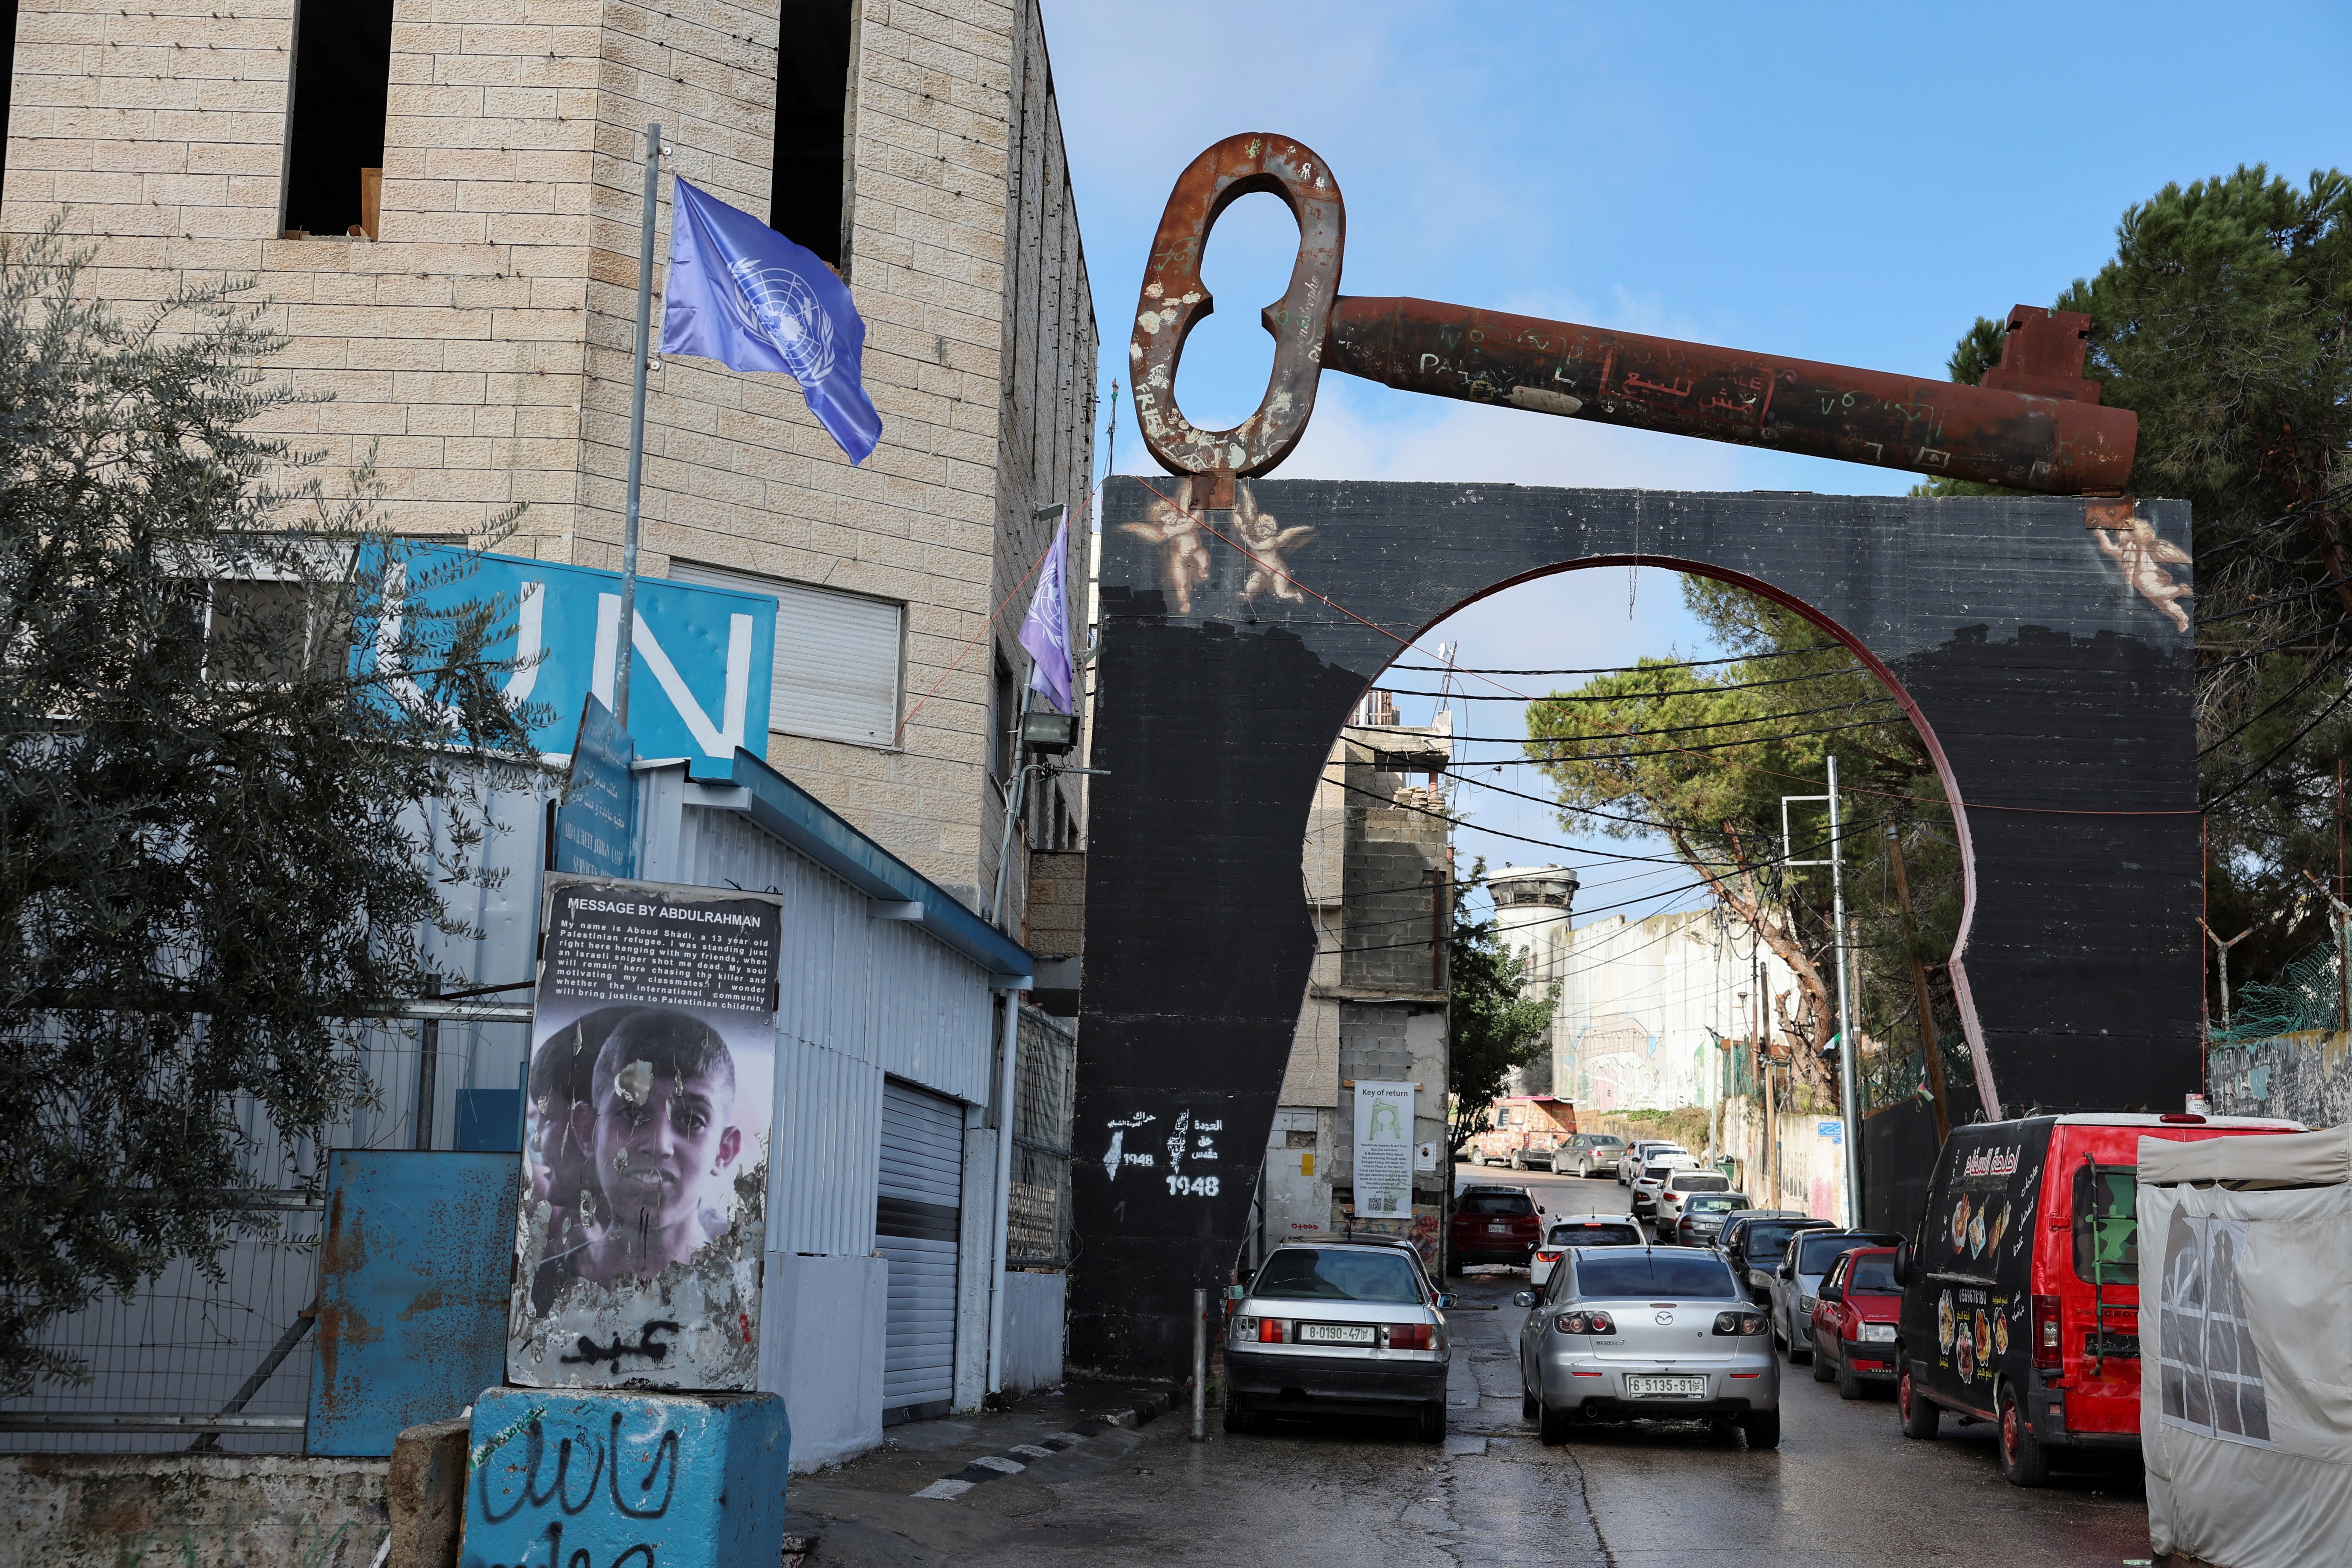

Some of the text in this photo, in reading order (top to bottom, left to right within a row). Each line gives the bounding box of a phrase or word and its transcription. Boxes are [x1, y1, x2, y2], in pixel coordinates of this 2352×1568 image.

[1622, 372, 1753, 414] مش للبيع
[376, 561, 753, 759] UN
[581, 830, 593, 850] BEIT
[568, 898, 760, 927] MESSAGE BY ABDULRAHMAN
[561, 920, 574, 929] My
[627, 927, 658, 935] Aboud
[664, 930, 694, 940] Shadi,
[560, 930, 618, 941] Palestinian
[624, 936, 665, 945] refugee.
[703, 944, 744, 955] standing
[560, 940, 584, 948] right
[589, 942, 610, 950] here
[615, 944, 655, 956] hanging
[659, 948, 680, 957] with
[702, 953, 739, 964] friends,
[576, 950, 609, 960] Israeli
[615, 954, 647, 963] sniper
[729, 965, 741, 973] My
[557, 978, 597, 987] whether
[637, 984, 701, 997] international
[713, 992, 765, 1004] community
[579, 989, 605, 999] bring
[609, 992, 644, 1001] justice
[648, 995, 657, 1003] to
[662, 996, 717, 1007] Palestinian
[721, 1002, 764, 1012] children.
[1194, 1120, 1223, 1131] العودة
[1198, 1136, 1213, 1146] حق
[1124, 1153, 1154, 1166] 1948
[1166, 1175, 1219, 1196] 1948
[2013, 1235, 2023, 1257] عندنا
[2076, 1308, 2138, 1317] PEGEOT
